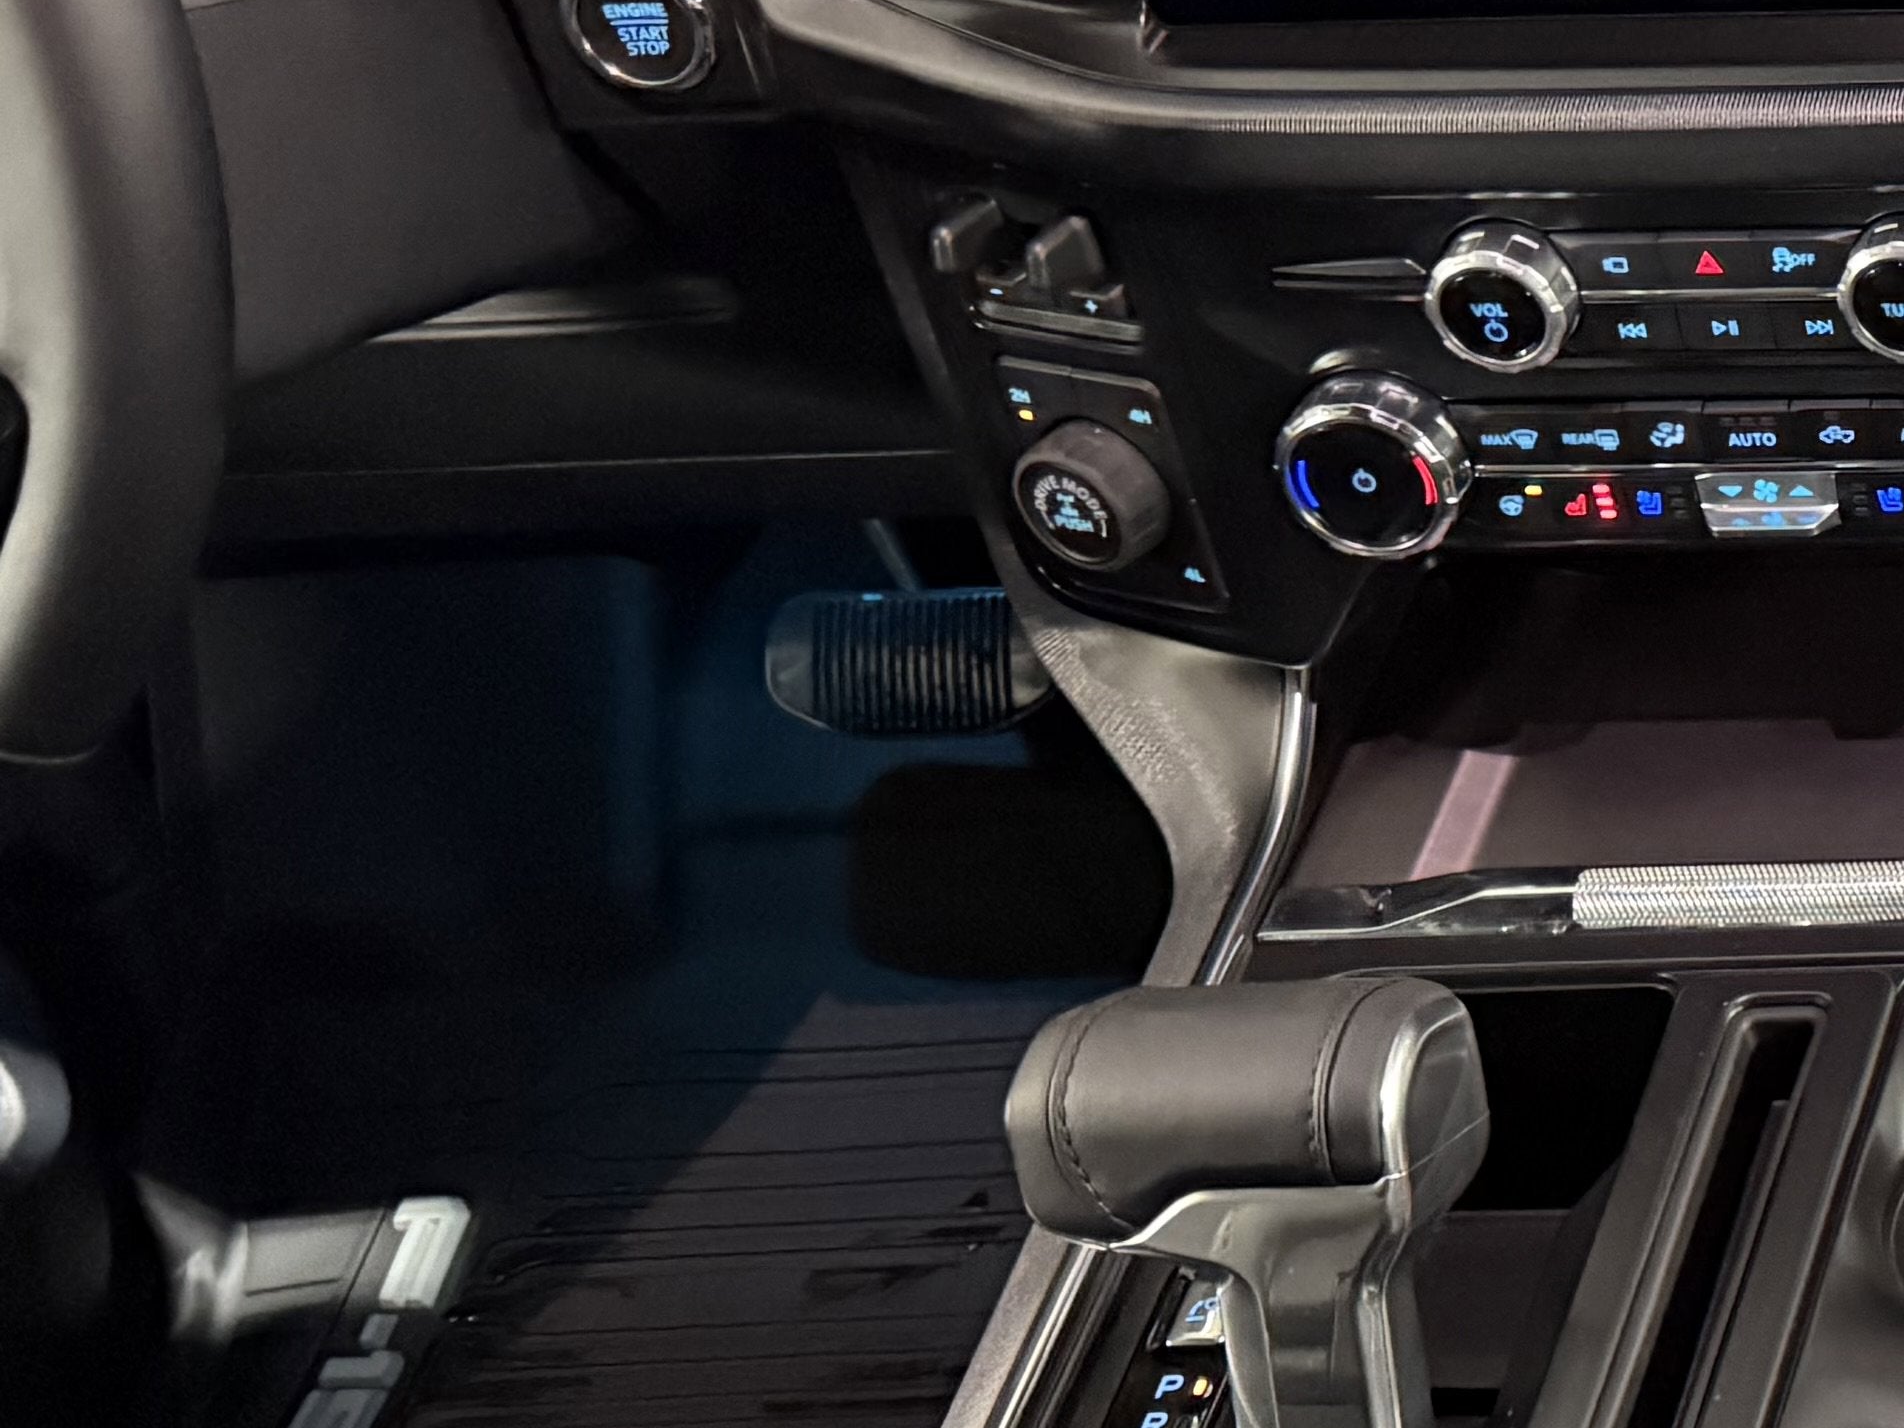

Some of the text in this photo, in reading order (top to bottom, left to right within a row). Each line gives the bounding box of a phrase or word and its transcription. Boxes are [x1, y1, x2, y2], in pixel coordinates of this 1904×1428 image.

[602, 1, 669, 20] ENGINE
[616, 25, 669, 43] START
[626, 40, 671, 57] STOP
[1791, 253, 1816, 267] OFF
[1470, 302, 1509, 318] VOL
[1480, 433, 1513, 447] MAX
[1561, 432, 1596, 446] REAR
[1728, 430, 1777, 449] AUTO
[1034, 474, 1108, 520] DRIVE MODE
[1054, 514, 1096, 533] PUSH
[1155, 1374, 1185, 1400] P
